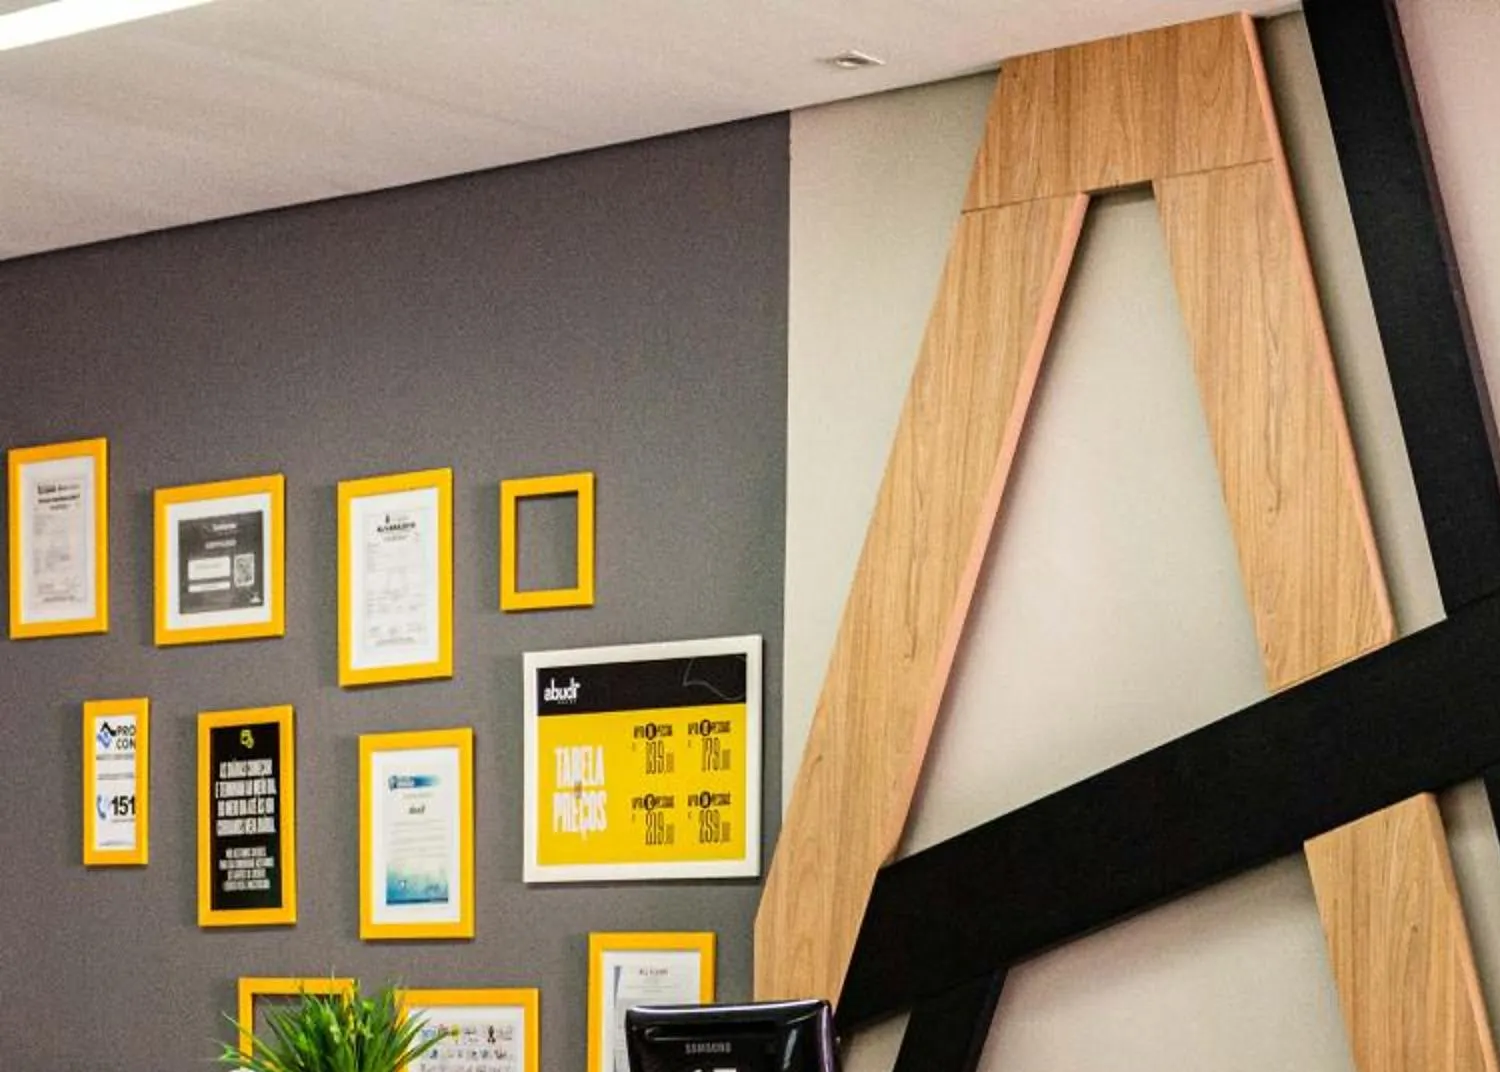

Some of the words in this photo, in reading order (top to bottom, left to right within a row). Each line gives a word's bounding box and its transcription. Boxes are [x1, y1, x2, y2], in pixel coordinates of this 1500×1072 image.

[116, 725, 136, 736] PRO
[554, 745, 605, 787] TABELA
[111, 795, 136, 815] 151
[685, 1042, 732, 1054] SAMSUNG
